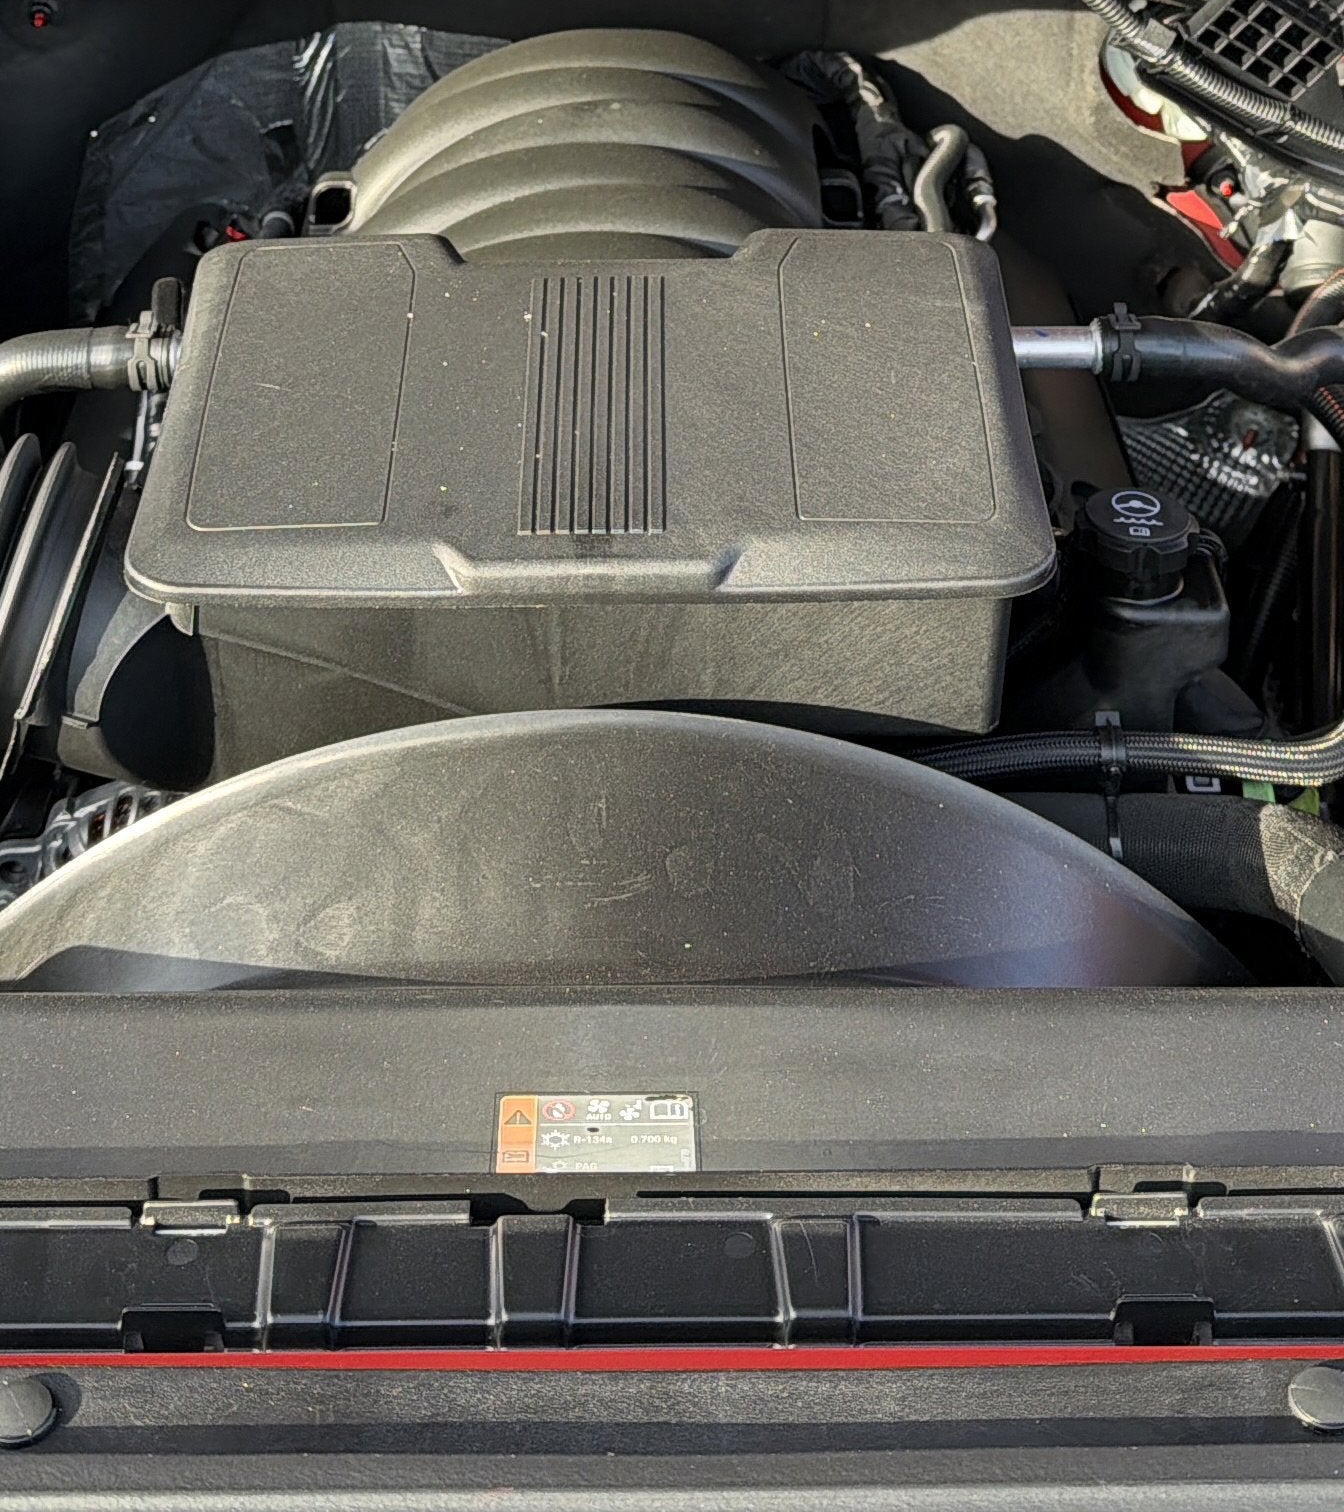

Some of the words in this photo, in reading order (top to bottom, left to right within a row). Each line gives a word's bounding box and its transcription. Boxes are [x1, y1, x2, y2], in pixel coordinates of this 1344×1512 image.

[586, 1113, 612, 1121] AUTO
[573, 1135, 613, 1144] R-134a
[630, 1135, 661, 1144] 0.700
[663, 1135, 678, 1145] kg
[575, 1162, 598, 1171] PAG
